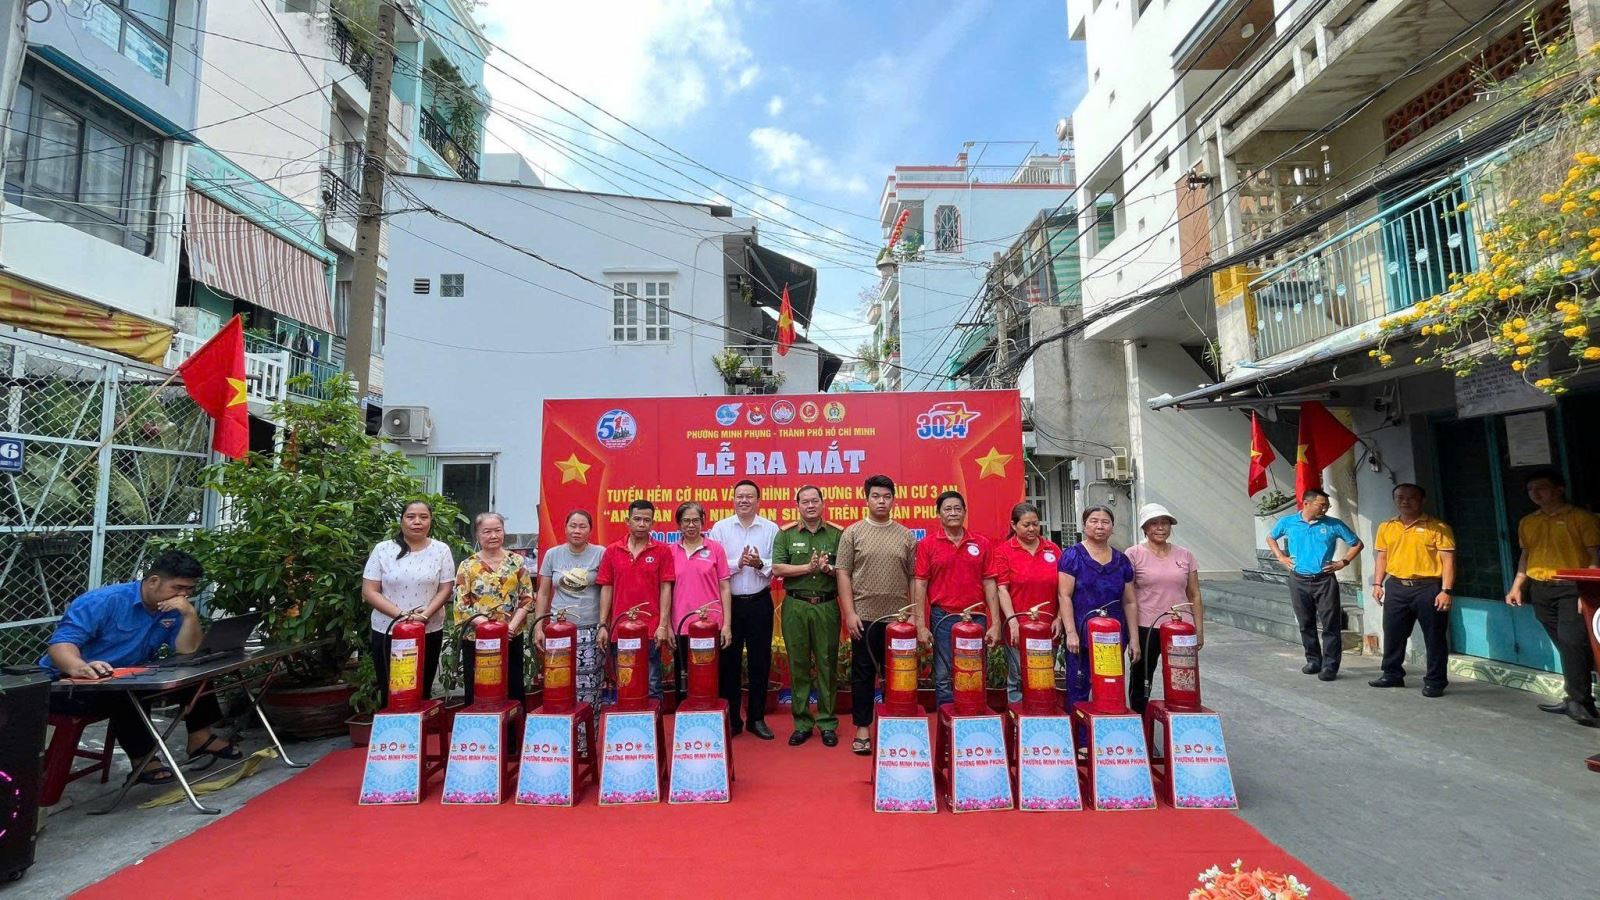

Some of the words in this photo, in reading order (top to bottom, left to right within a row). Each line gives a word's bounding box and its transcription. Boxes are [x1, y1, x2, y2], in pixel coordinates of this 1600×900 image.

[687, 429, 719, 439] PHƯỜNG
[721, 430, 742, 439] MINH
[744, 429, 771, 439] PHỤNG
[779, 427, 805, 437] THÀNH
[807, 426, 823, 437] PHỐ
[825, 426, 836, 437] HỒ
[838, 427, 852, 436] CHÍ
[853, 427, 876, 436] MINH
[696, 441, 736, 476] LỄ
[745, 451, 788, 476] RA
[798, 440, 866, 475] MẮT
[607, 485, 644, 502] TUYẾN
[647, 484, 672, 502] HẺM
[676, 486, 692, 502] CỜ
[695, 488, 718, 502] HOA
[762, 485, 790, 501] HÌNH
[911, 484, 928, 499] CƯ
[930, 485, 937, 499] 3
[828, 504, 859, 520] TRÊN
